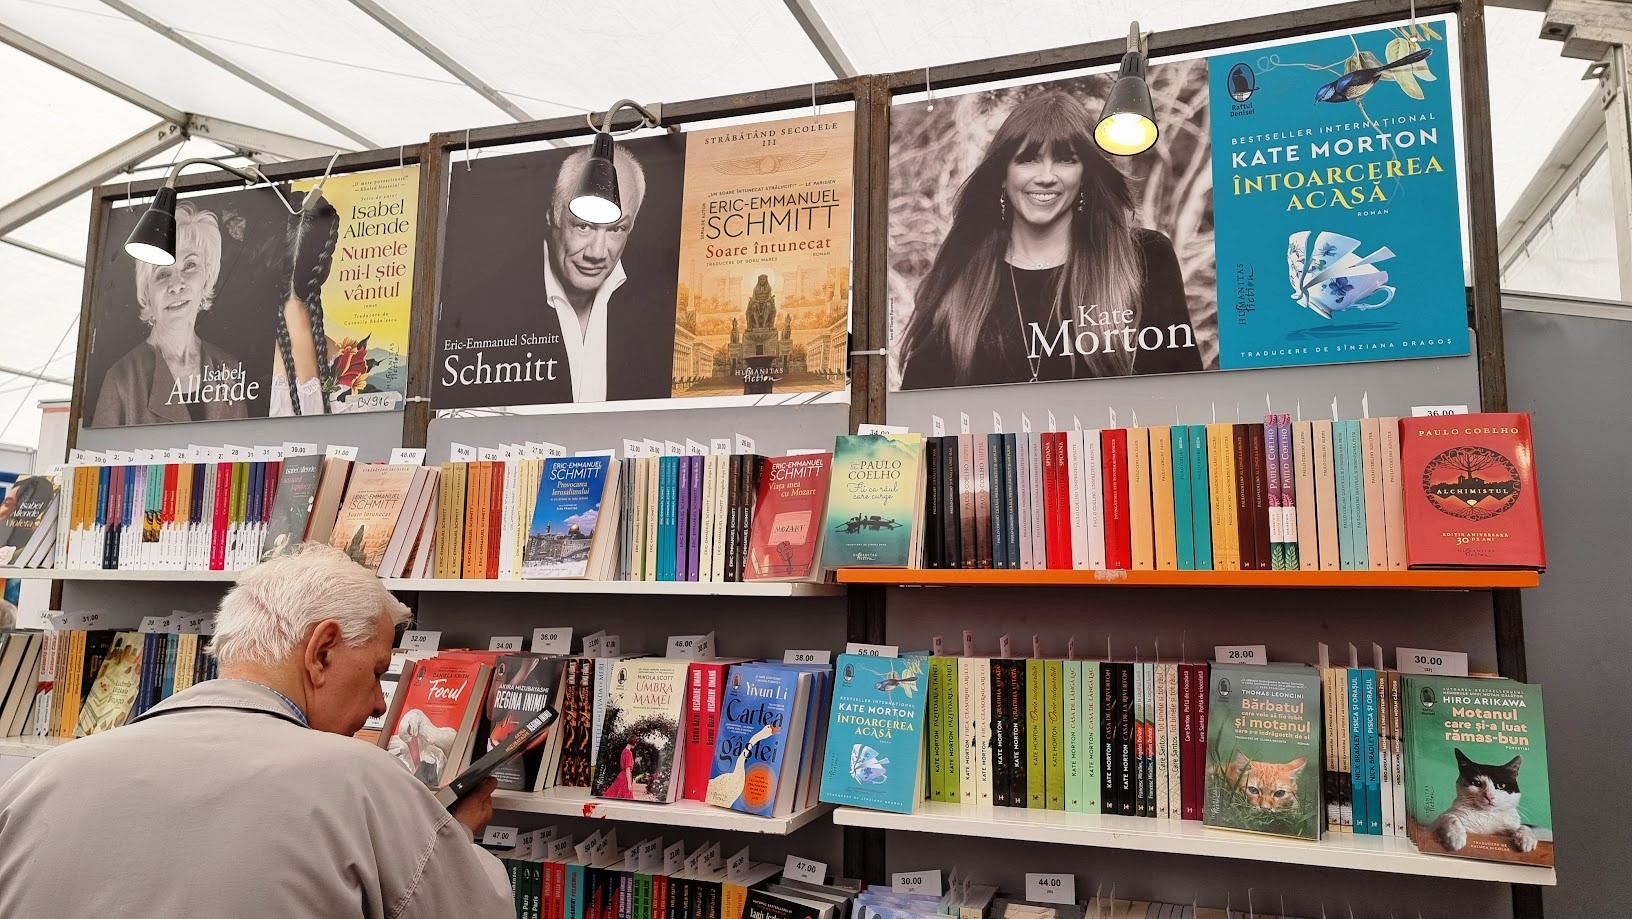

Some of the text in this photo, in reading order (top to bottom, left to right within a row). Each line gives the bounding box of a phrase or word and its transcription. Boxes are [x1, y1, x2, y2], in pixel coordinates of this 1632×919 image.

[1231, 102, 1253, 111] Raftul
[704, 122, 838, 145] STRĂBĂTÂND SECOLELE
[1231, 112, 1436, 146] BESTSELLER INTERNAȚIONAL
[762, 139, 777, 147] III
[1231, 127, 1438, 169] KATE MORTON
[1232, 155, 1444, 196] ÎNTOARCEREA
[709, 189, 840, 215] ERIC-EMMANUEL
[1285, 181, 1388, 212] ACASĂ
[352, 198, 404, 220] Isabel
[1357, 209, 1390, 217] ROMAN
[343, 217, 409, 239] Allende
[706, 204, 840, 240] SCHMITT
[340, 240, 408, 261] Numele
[705, 238, 832, 259] Soare întunecat
[339, 262, 407, 283] mi-l știe
[344, 281, 400, 301] vântul
[1077, 304, 1134, 328] Kate
[444, 333, 559, 351] Eric-Emmanuel Schmitt
[1026, 319, 1196, 359] Morton
[1240, 347, 1308, 358] TRADUCERE
[1336, 342, 1395, 352] SÎNZIANA
[1402, 338, 1453, 347] DRAGOȘ
[203, 362, 242, 382] Isabel
[441, 351, 558, 387] Schmitt
[735, 368, 784, 376] HUMANITAS
[165, 370, 260, 405] Allende
[1419, 427, 1519, 437] PAULO COELHO
[1268, 428, 1276, 460] COELHO
[552, 461, 602, 470] ERIC-EMMANUEL
[771, 459, 824, 470] ERIC-EMMANUEL
[860, 460, 902, 470] PAULO
[549, 468, 602, 480] SCHMITT
[769, 465, 823, 481] SCHMITT
[848, 470, 901, 480] COELHO
[557, 481, 588, 489] Provocarea
[768, 482, 785, 491] Viața
[352, 493, 401, 501] ERIC-EMMANUEL
[791, 488, 817, 497] Mozart
[349, 500, 399, 510] SCHMITT
[5, 519, 34, 528] Violeta
[1456, 537, 1469, 545] 30
[82, 614, 99, 622] 31.00
[540, 633, 558, 641] 36.00
[795, 654, 814, 662] 38.00
[858, 648, 880, 657] 55.00
[1228, 650, 1254, 659] 28.00
[1414, 655, 1443, 666] 30.00
[428, 678, 468, 702] Focul
[498, 683, 550, 693] AKIRA MIZUBAYASHI
[636, 681, 674, 693] UMBRA
[745, 681, 788, 700] Yiyun Li
[633, 692, 671, 705] MAMEI
[1241, 689, 1304, 700] THOMAS LEONCINI
[1105, 702, 1111, 711] LA
[1241, 698, 1304, 715] Bărbatul
[1353, 704, 1359, 712] ȘI
[1443, 696, 1526, 708] HIRO ARIKAWA
[726, 698, 784, 728] Cartea
[838, 702, 915, 719] KATE MORTON
[1106, 712, 1111, 720] DE
[1452, 707, 1518, 721] Motanul
[837, 713, 914, 732] ÎNTOARCEREA
[1234, 716, 1311, 733] și motanul
[1444, 720, 1528, 733] care și-a luat
[855, 726, 892, 739] ACASĂ
[1258, 729, 1293, 740] îndrăgostit
[1445, 729, 1529, 746] rămas-bun
[717, 735, 779, 772] gâștei
[492, 831, 509, 840] 47.00
[796, 862, 817, 873] 47.00
[901, 877, 922, 885] 30.00
[1038, 878, 1061, 887] 44.00
